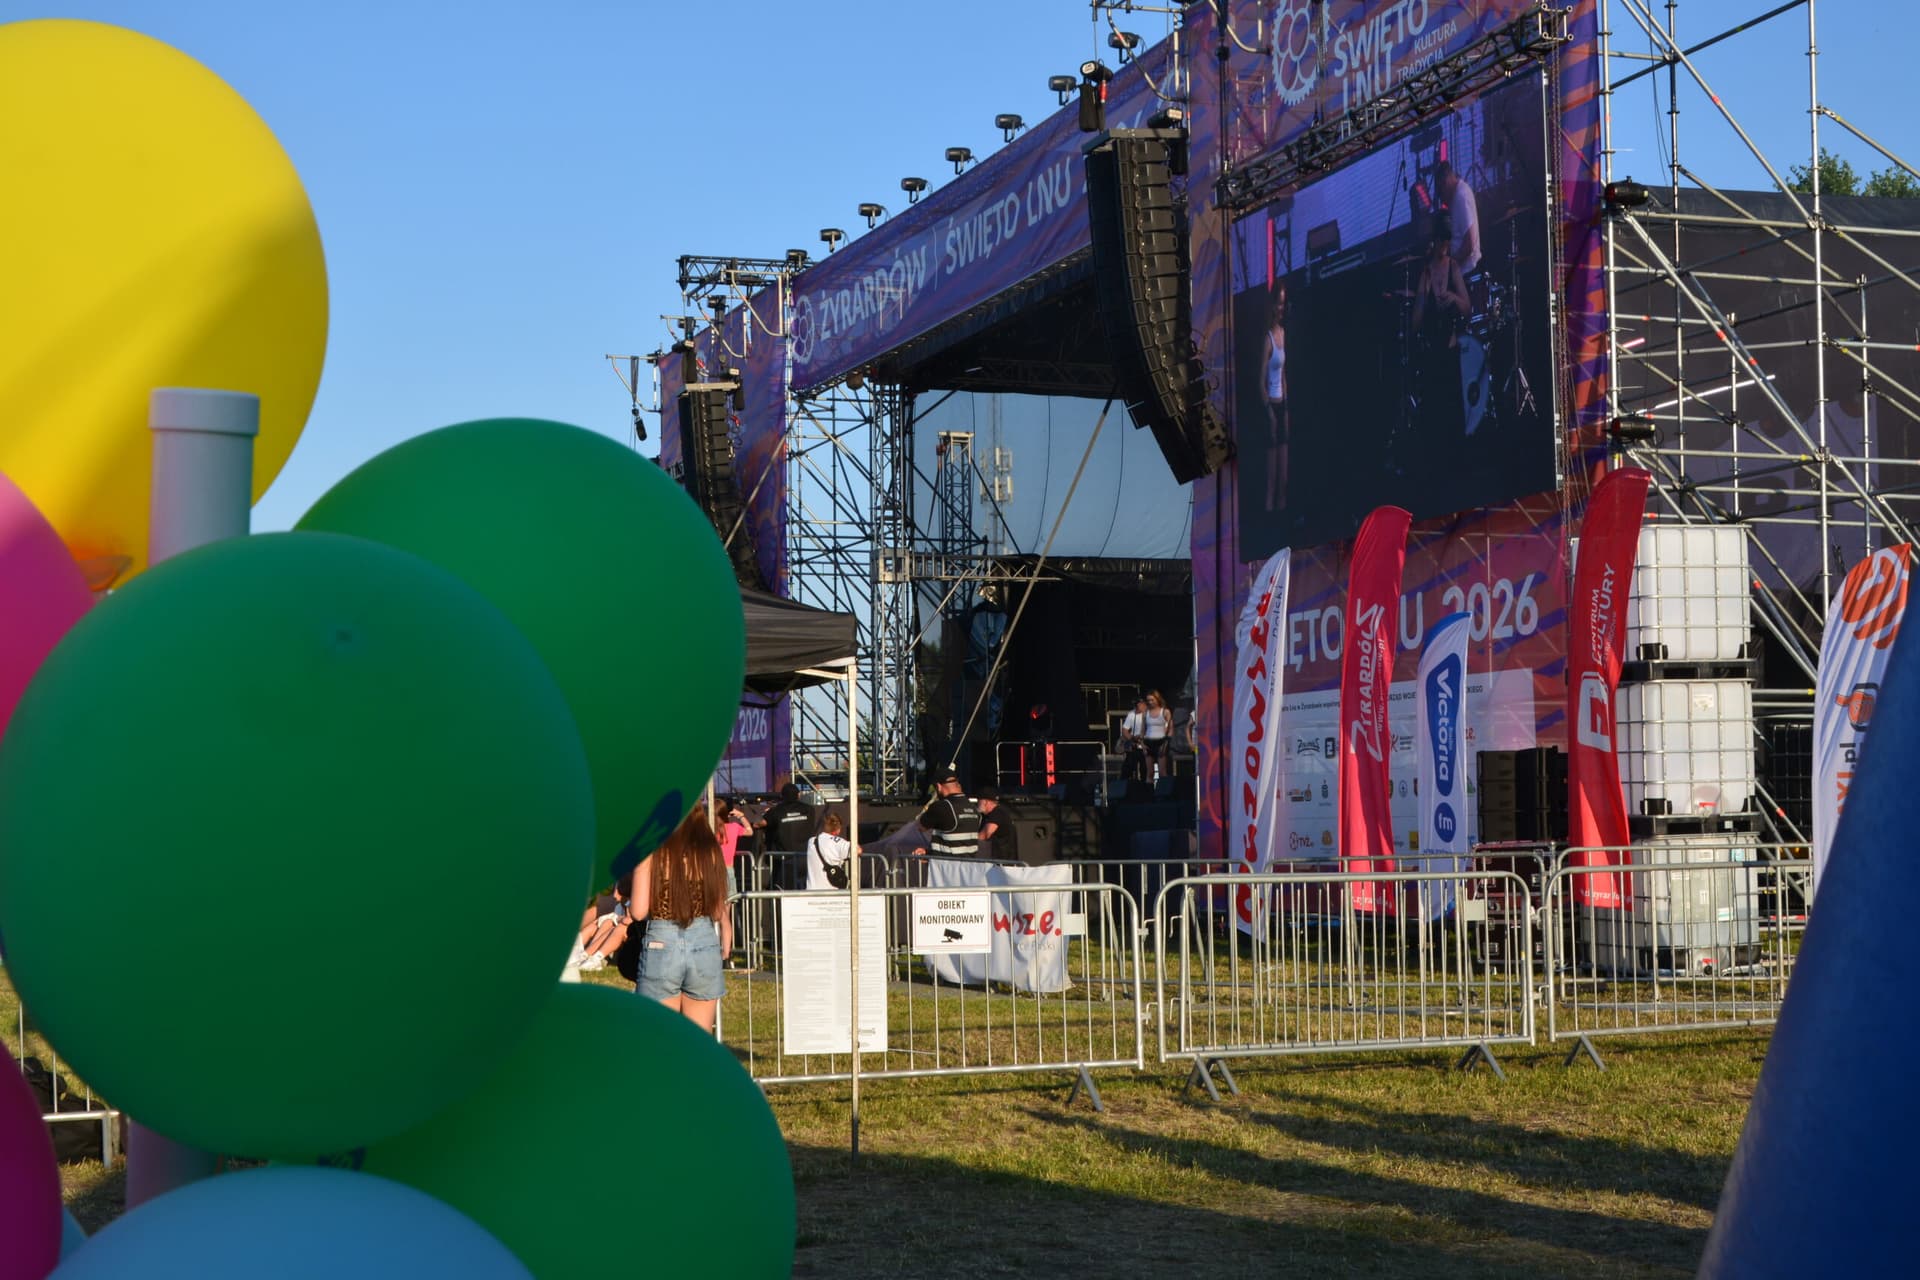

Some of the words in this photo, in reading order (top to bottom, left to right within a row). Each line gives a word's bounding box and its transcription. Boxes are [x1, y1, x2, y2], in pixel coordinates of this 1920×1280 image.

[1414, 20, 1457, 54] KULTURA
[820, 246, 927, 341] ŻYRARDÓW
[945, 191, 1020, 275] ŚWIĘTO
[1027, 156, 1071, 227] LNU
[738, 709, 768, 742] 2026
[1437, 668, 1454, 781] Victoria
[1438, 813, 1453, 831] fm
[919, 915, 985, 925] MONITOROWANY
[938, 900, 966, 911] OBIEKT
[993, 910, 1062, 936] wsze.
